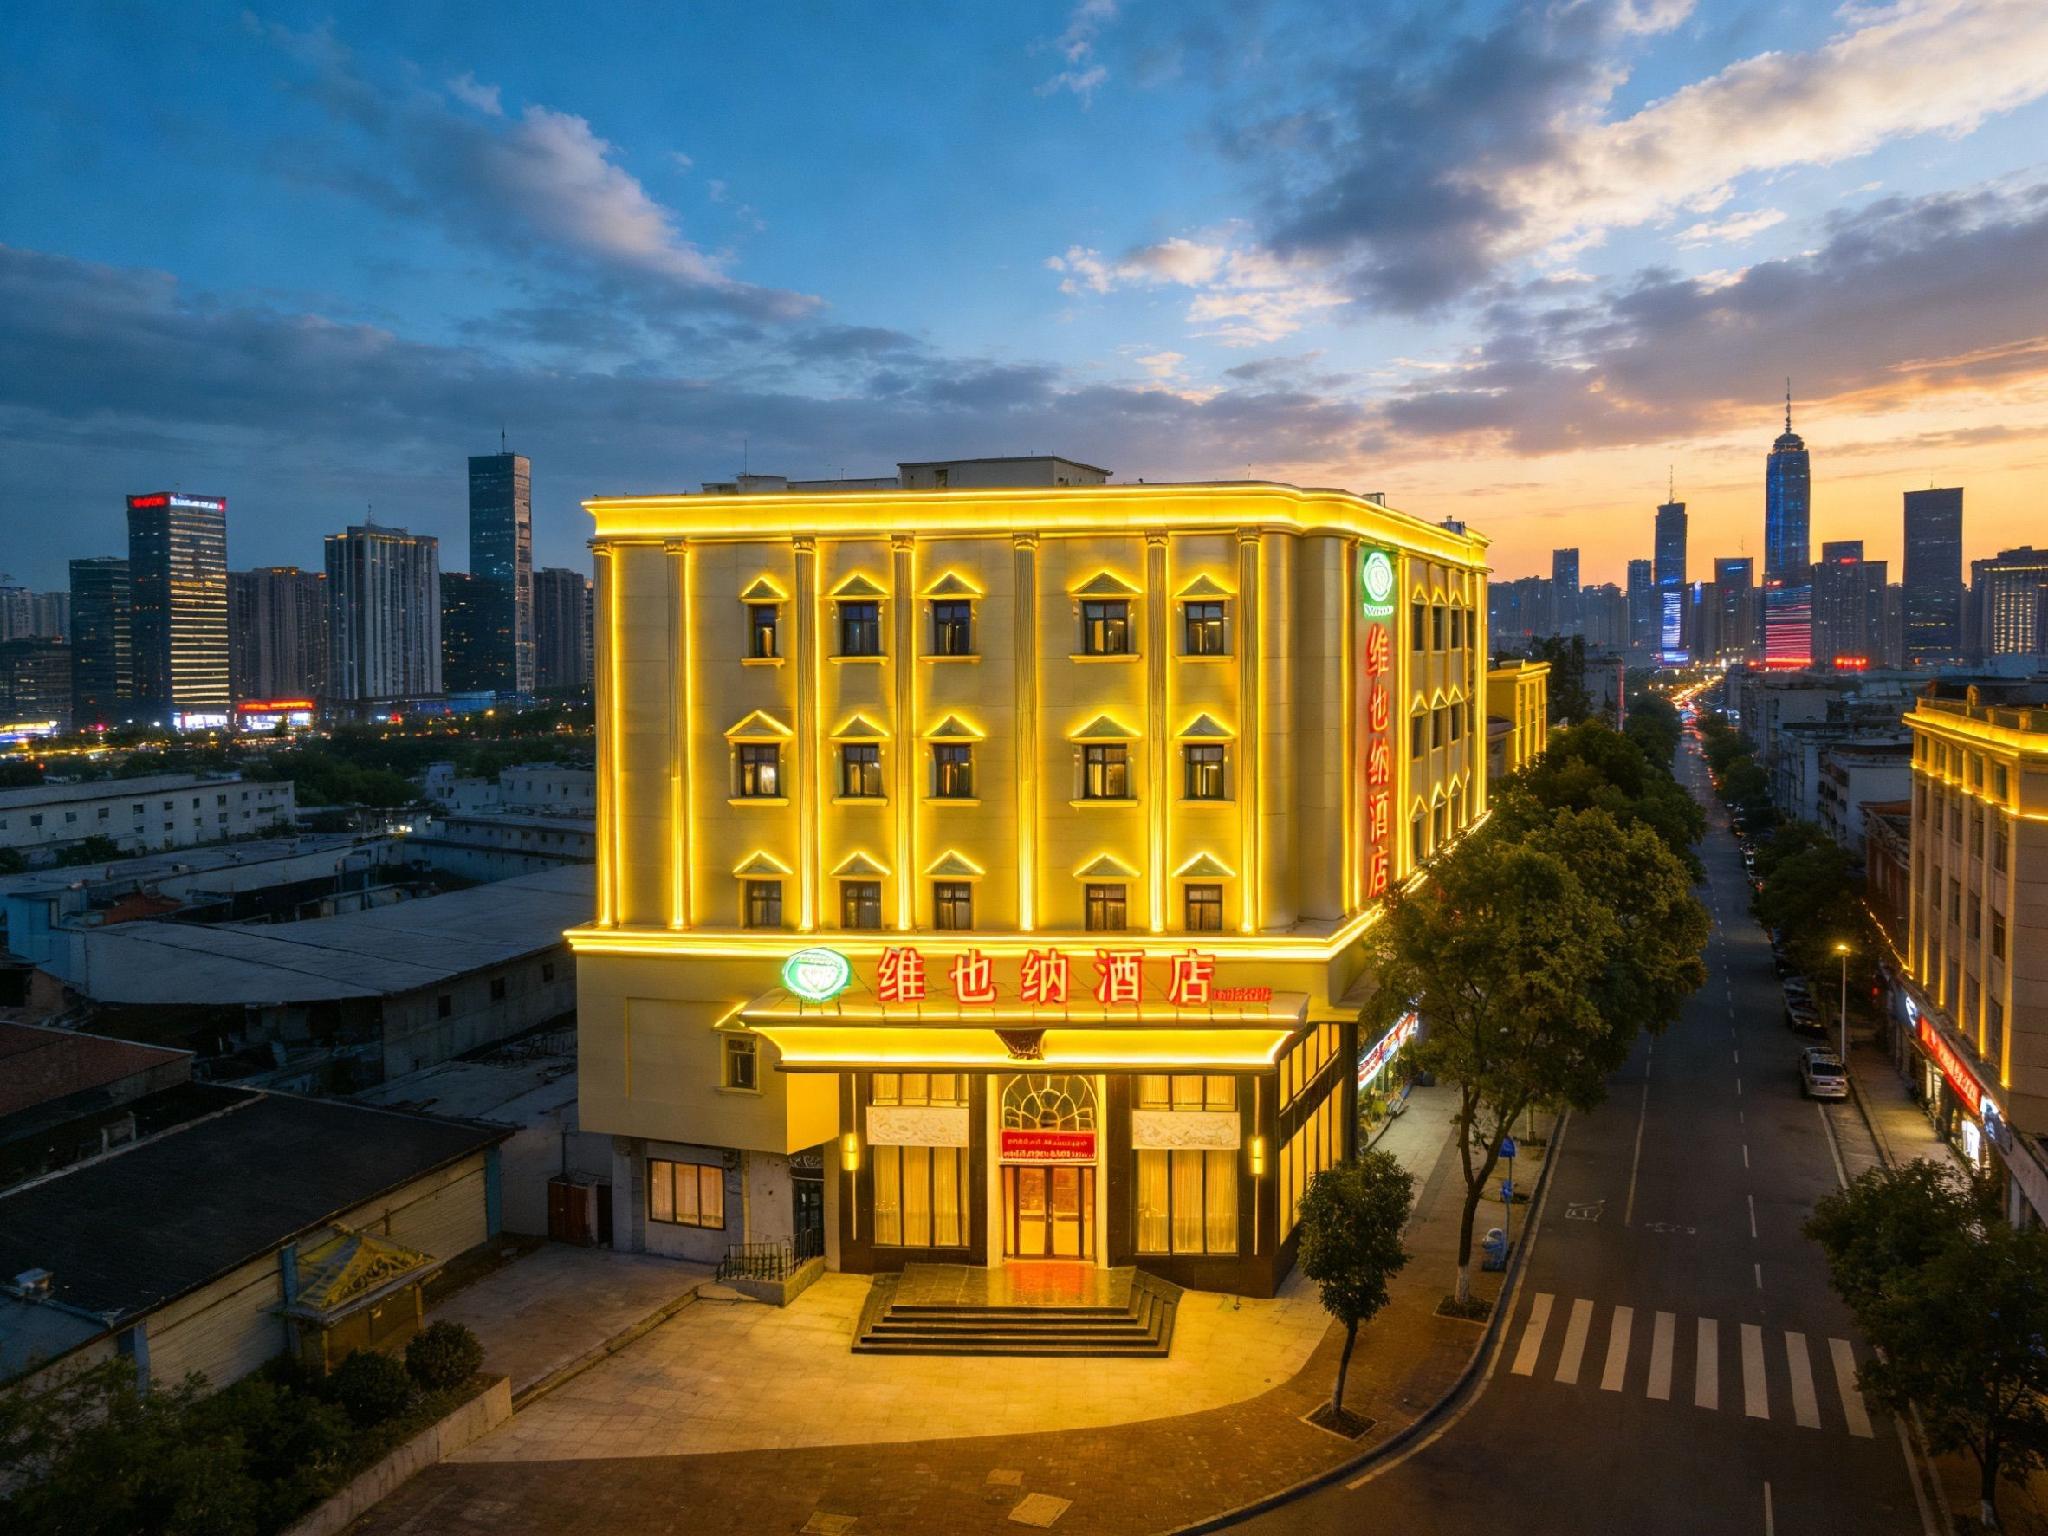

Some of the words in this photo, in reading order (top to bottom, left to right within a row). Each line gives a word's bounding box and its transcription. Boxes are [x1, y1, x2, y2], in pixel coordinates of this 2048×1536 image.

[1367, 622, 1390, 900] 维也纳酒店
[878, 947, 1216, 1007] 维也纳酒店
